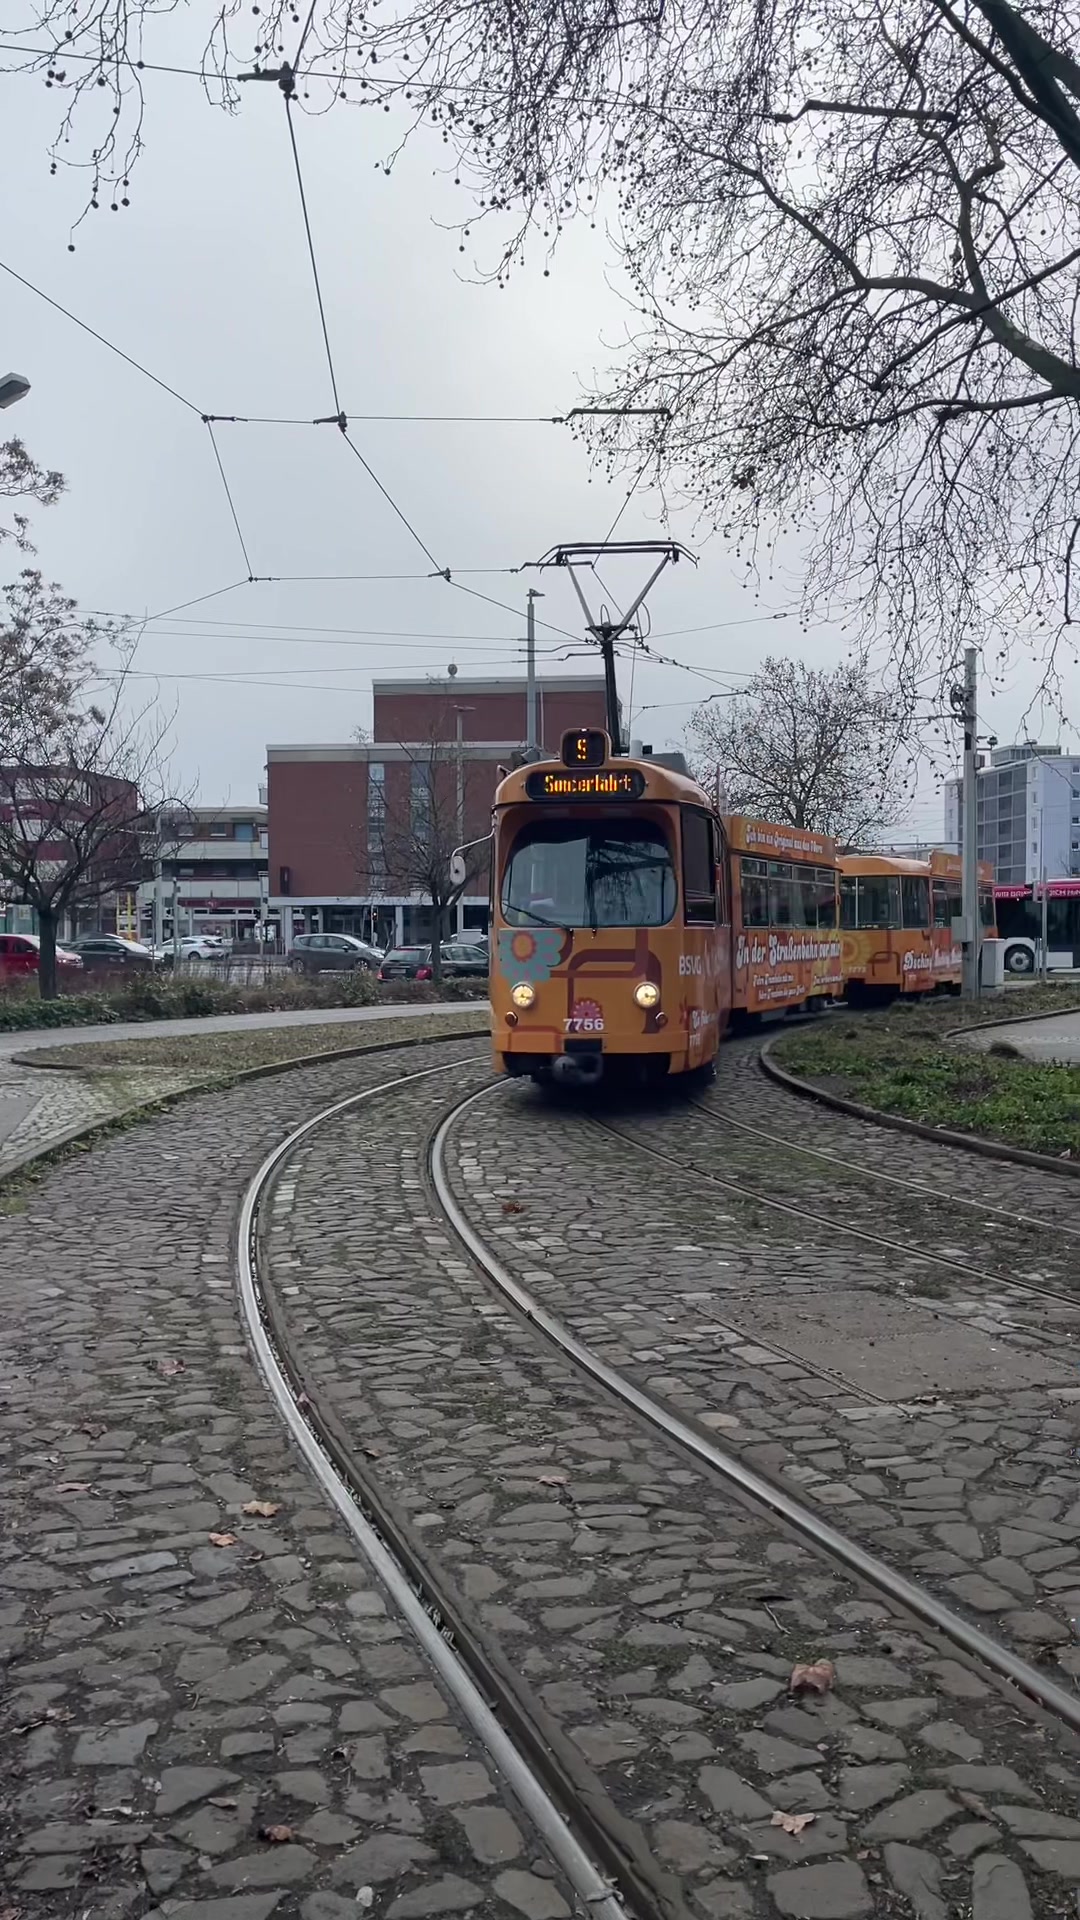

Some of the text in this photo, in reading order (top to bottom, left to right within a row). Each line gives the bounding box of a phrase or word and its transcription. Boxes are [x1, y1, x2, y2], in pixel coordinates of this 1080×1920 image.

[751, 936, 766, 963] der
[679, 954, 702, 976] BSVG
[563, 1018, 605, 1032] 7756
